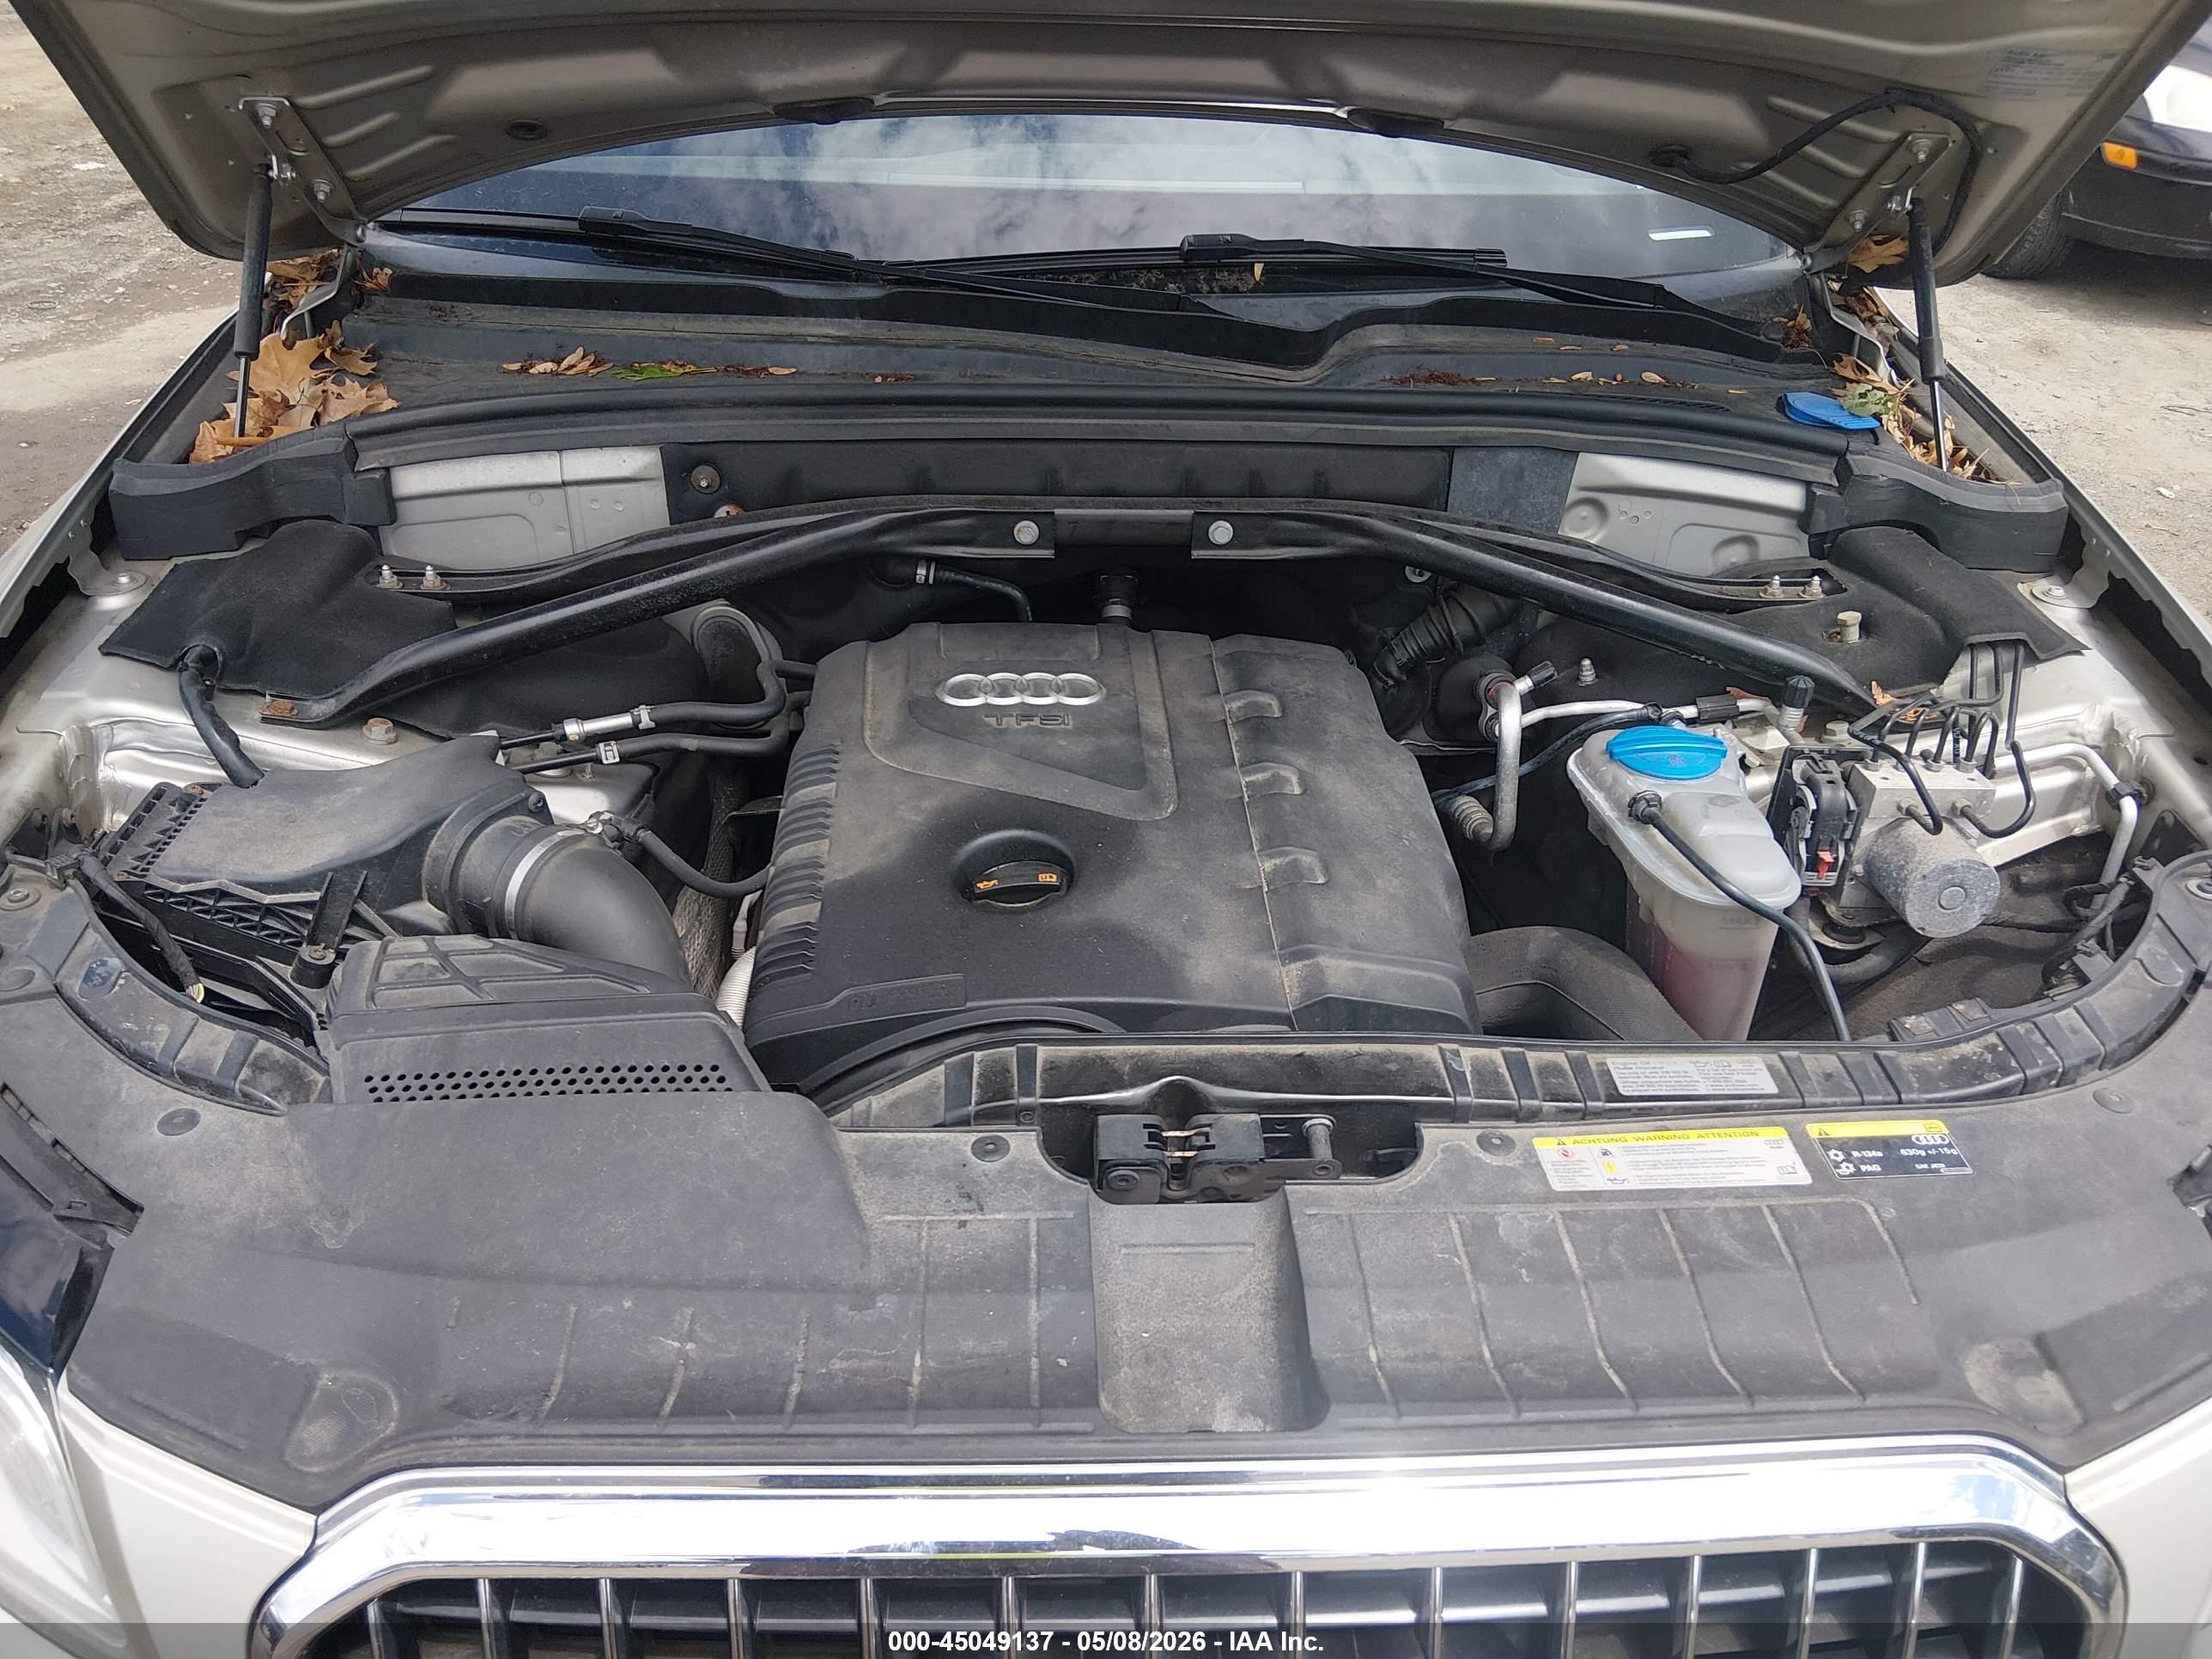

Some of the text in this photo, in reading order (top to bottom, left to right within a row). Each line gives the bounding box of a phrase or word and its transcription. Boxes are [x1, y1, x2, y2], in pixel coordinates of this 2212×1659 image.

[984, 714, 1072, 728] TFSI
[1572, 1130, 1759, 1146] ACHTUNG WARNING ATTENTION
[1900, 1148, 1926, 1157] 630g
